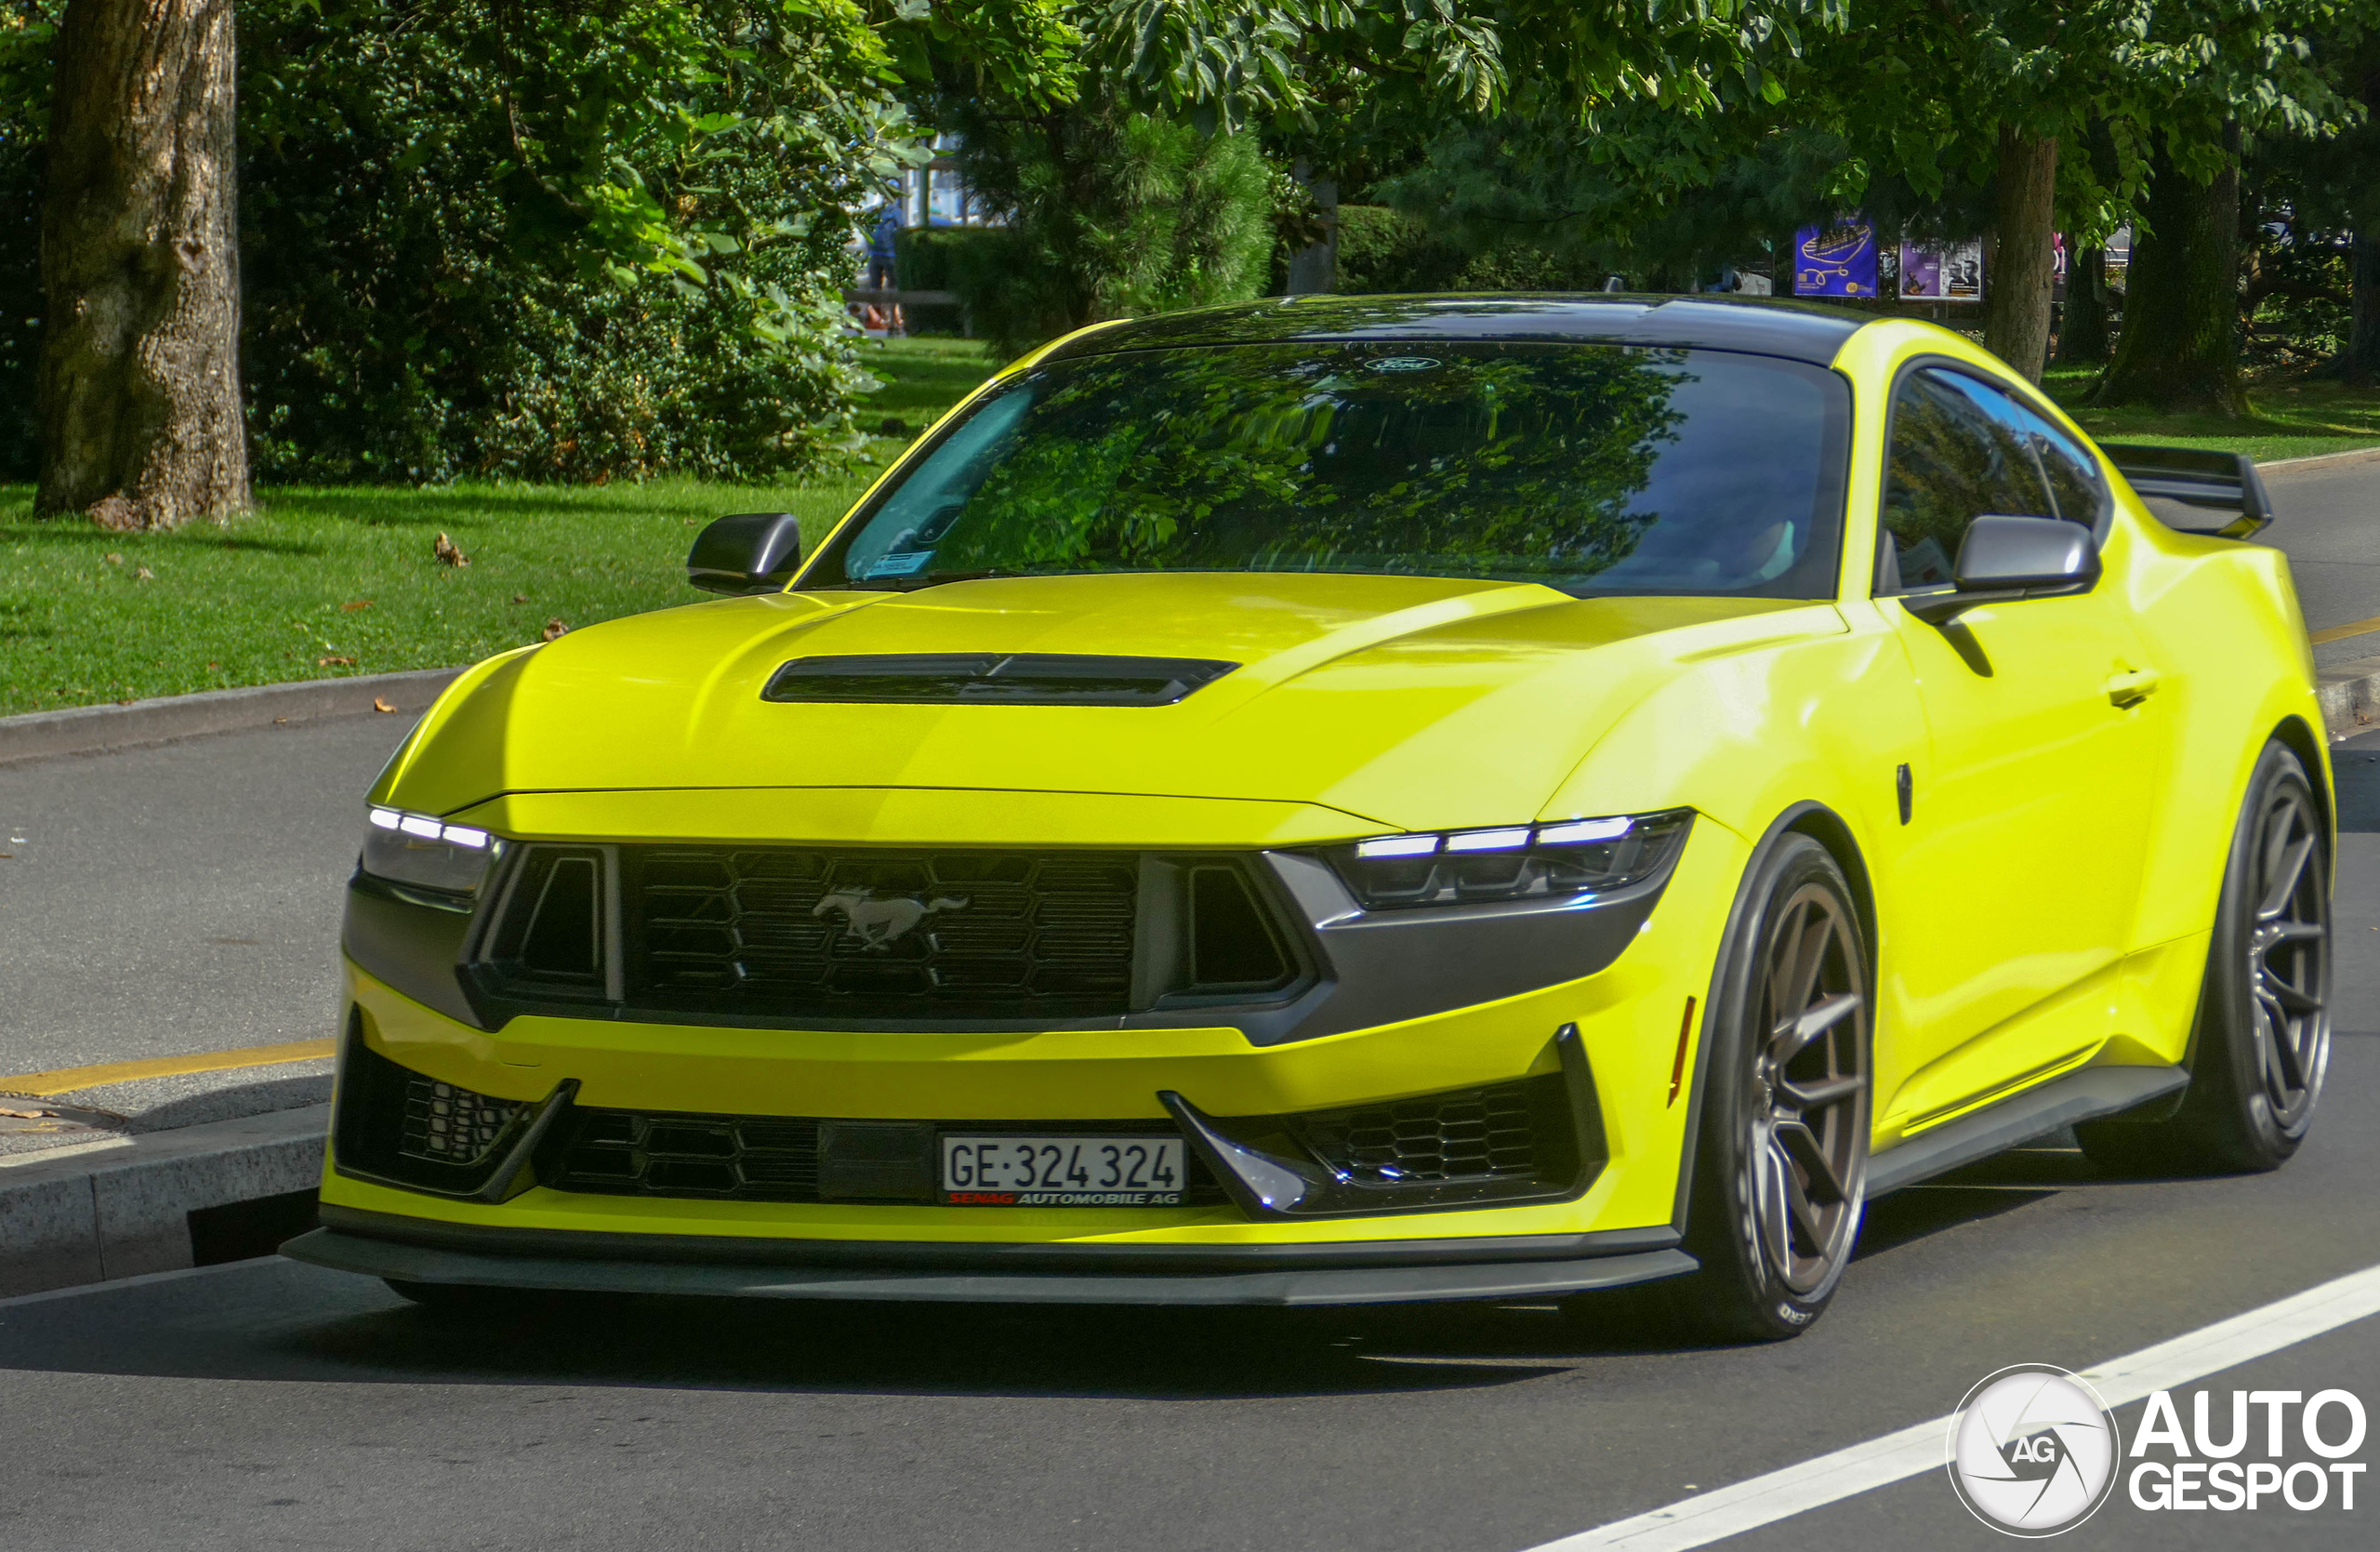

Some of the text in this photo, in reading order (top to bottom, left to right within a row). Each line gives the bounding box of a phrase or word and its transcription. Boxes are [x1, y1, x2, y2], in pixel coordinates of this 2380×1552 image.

[1099, 1145, 1175, 1188] 324
[948, 1192, 1180, 1205] SENAG AUTOMOBILE AG
